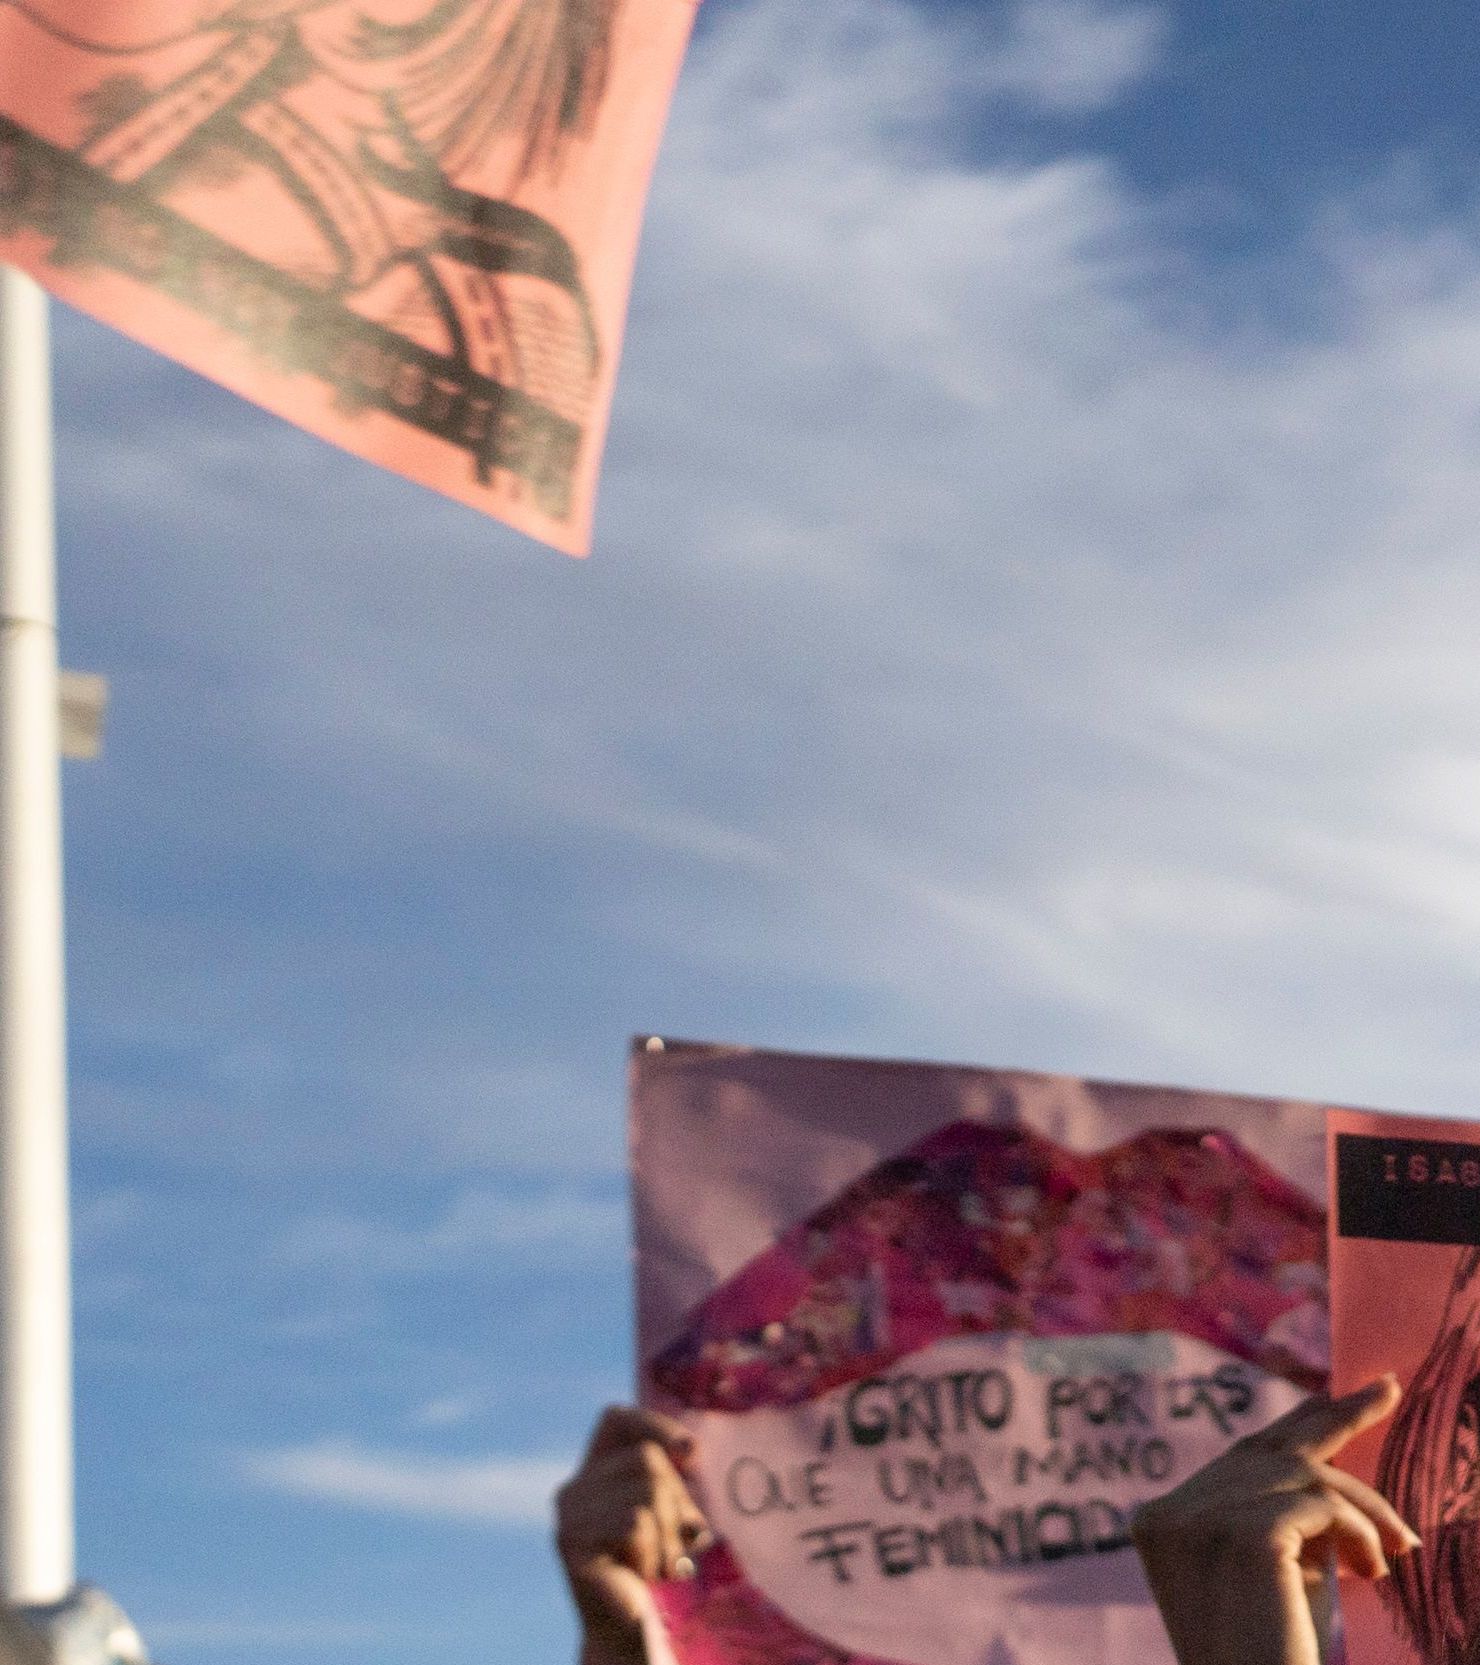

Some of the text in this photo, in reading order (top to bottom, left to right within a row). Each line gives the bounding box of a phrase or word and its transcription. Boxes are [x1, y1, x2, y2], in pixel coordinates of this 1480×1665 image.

[1047, 1374, 1153, 1438] POR
[1164, 1366, 1255, 1436] LAS
[727, 1438, 1174, 1517] QUE UNA MANO
[800, 1502, 1142, 1585] FEMINICID
